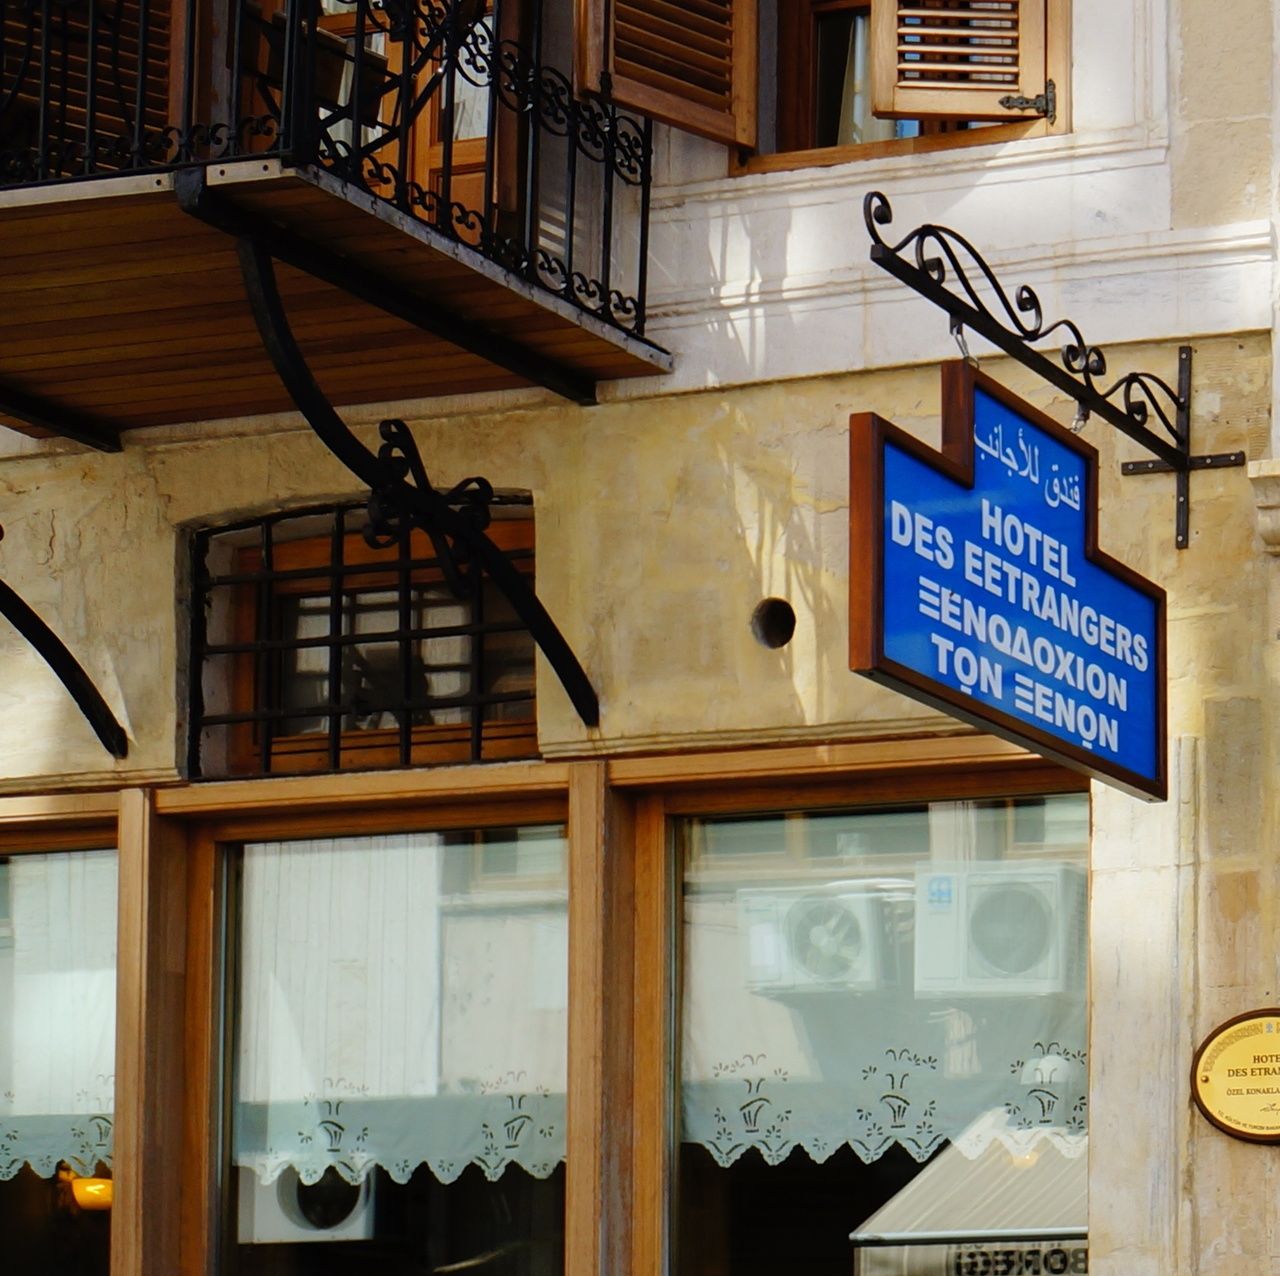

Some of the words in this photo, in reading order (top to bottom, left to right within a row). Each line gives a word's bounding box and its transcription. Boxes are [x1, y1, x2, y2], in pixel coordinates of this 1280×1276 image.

[1044, 463, 1081, 511] فندق
[981, 498, 1076, 587] HOTEL
[890, 499, 955, 570] DES
[964, 540, 1148, 672] EETRANGERS
[1227, 1068, 1248, 1078] DES
